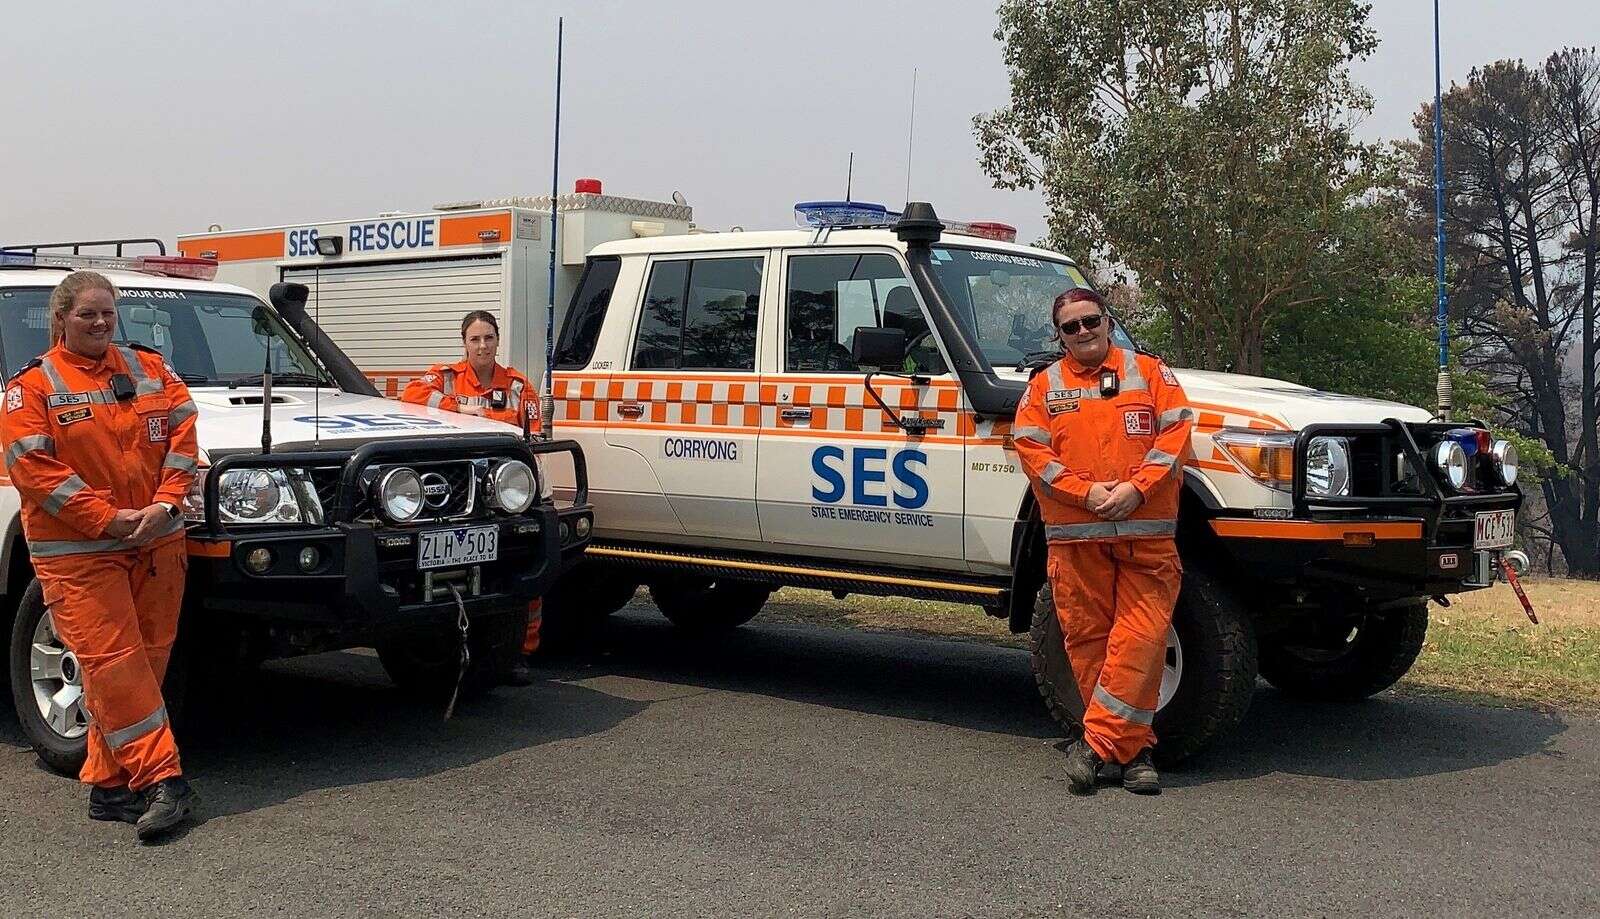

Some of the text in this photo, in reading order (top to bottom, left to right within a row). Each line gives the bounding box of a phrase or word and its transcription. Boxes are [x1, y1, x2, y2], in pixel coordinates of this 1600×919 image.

[289, 219, 435, 257] SES RESCUE
[970, 251, 1012, 263] CORRYONG
[154, 290, 179, 299] CAR
[592, 361, 610, 370] LOCKER
[59, 395, 80, 403] SES
[1055, 391, 1073, 399] SES
[293, 413, 442, 429] SES
[664, 437, 738, 461] CORRYONG
[971, 462, 1015, 473] MDT 5750
[811, 445, 930, 510] SES
[811, 506, 934, 527] STATE EMERGENCY SERVICE
[422, 531, 495, 560] ZLH 503
[421, 559, 445, 567] VICTORIA
